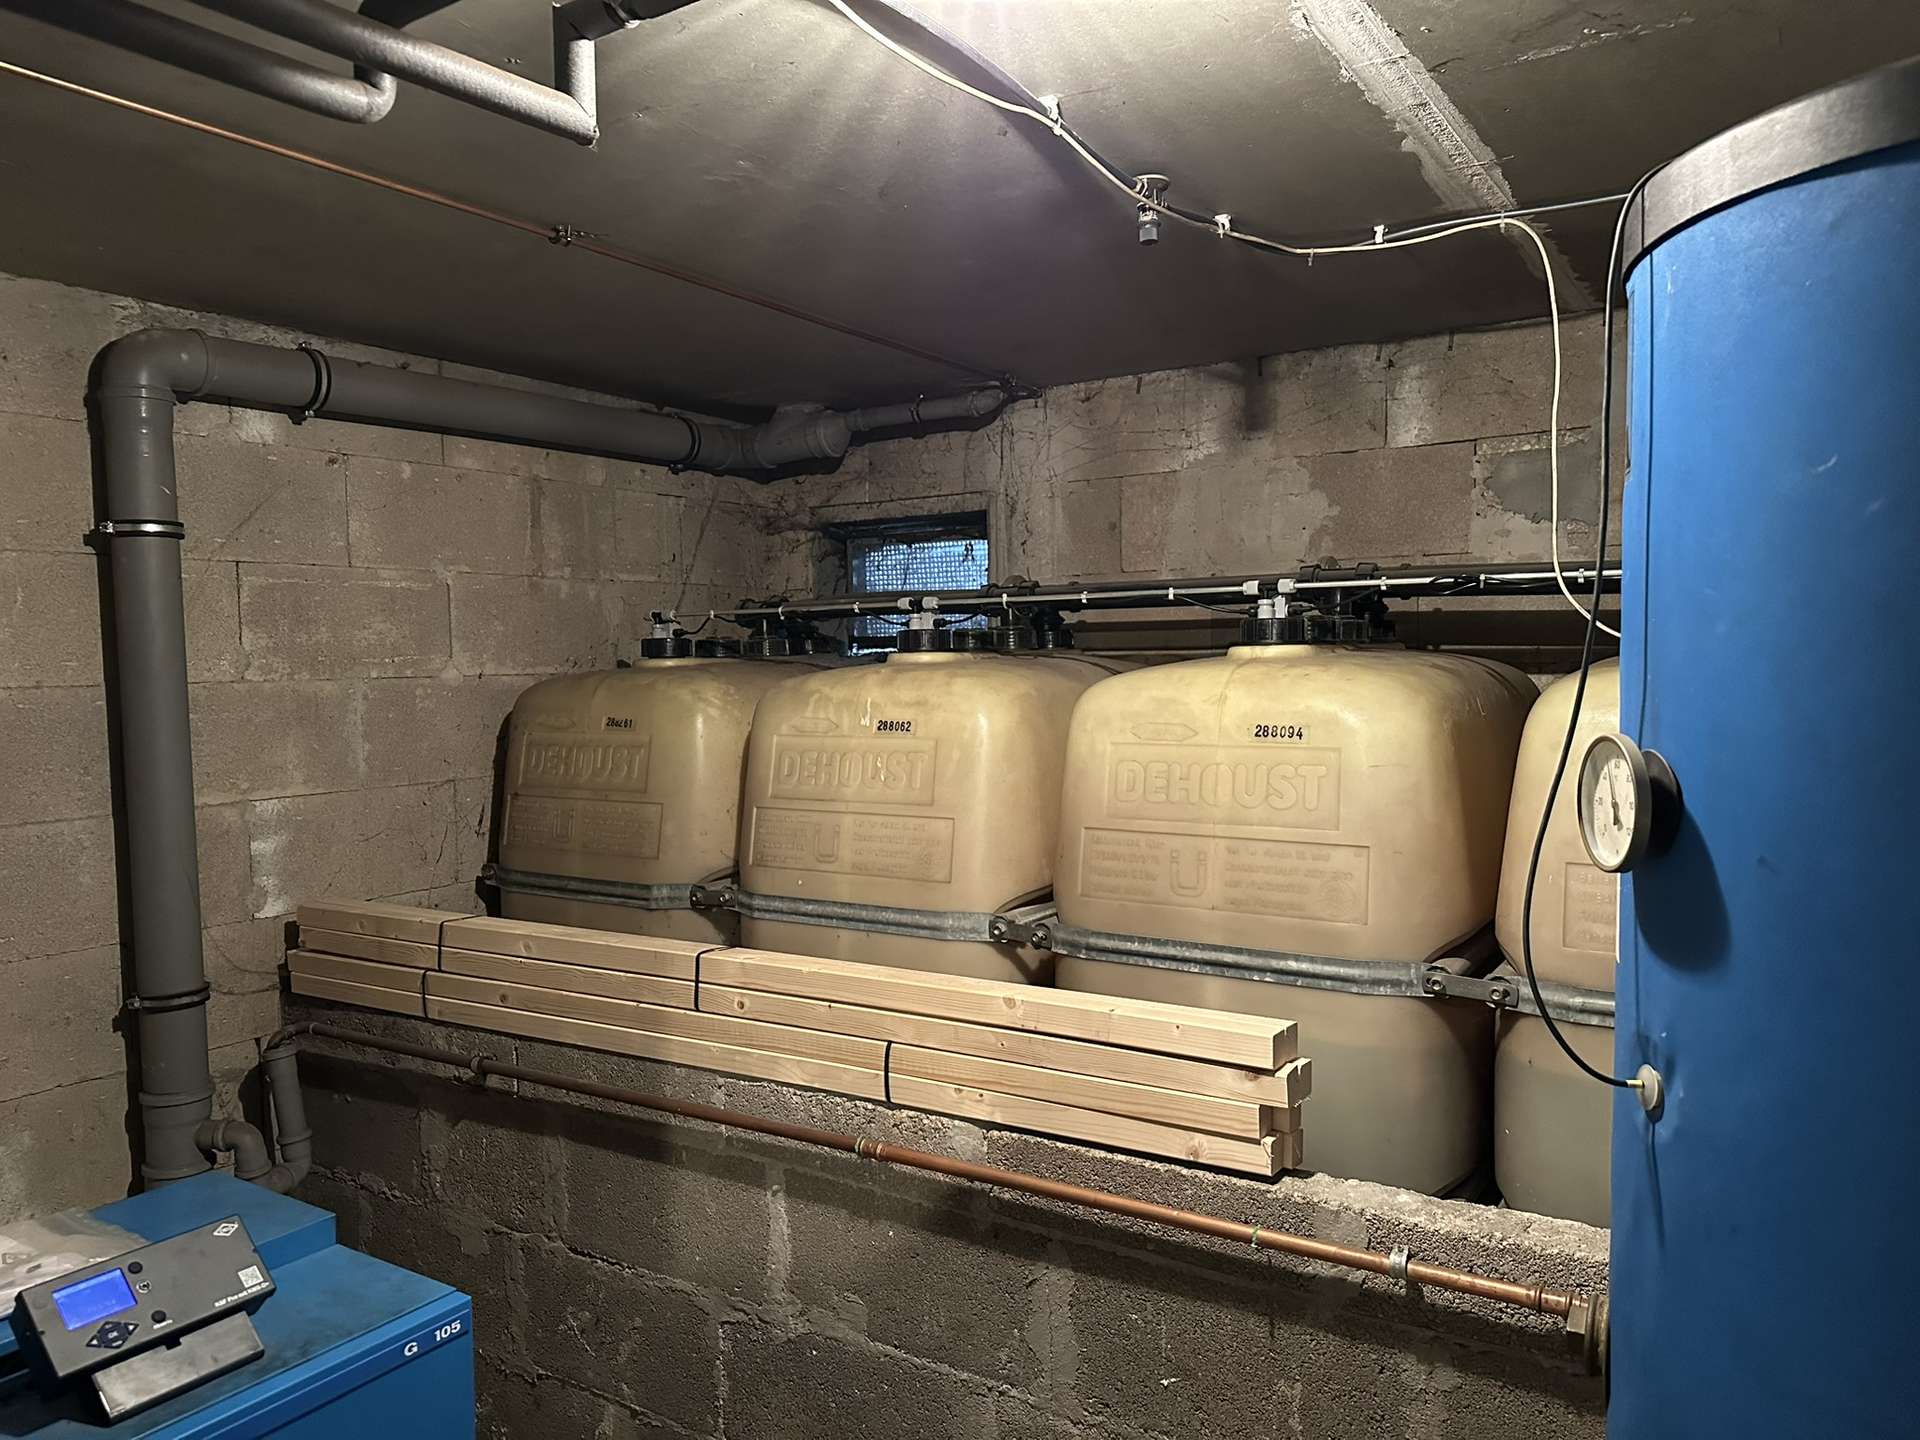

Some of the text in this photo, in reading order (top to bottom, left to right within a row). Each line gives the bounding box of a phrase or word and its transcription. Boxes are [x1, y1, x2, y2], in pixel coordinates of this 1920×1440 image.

[877, 719, 911, 731] 288062
[1254, 724, 1303, 740] 288094
[527, 743, 645, 779] DEHOUST
[776, 751, 928, 790] DEHOUST
[1115, 760, 1327, 811] DEHOUST
[404, 1320, 460, 1356] G 105
